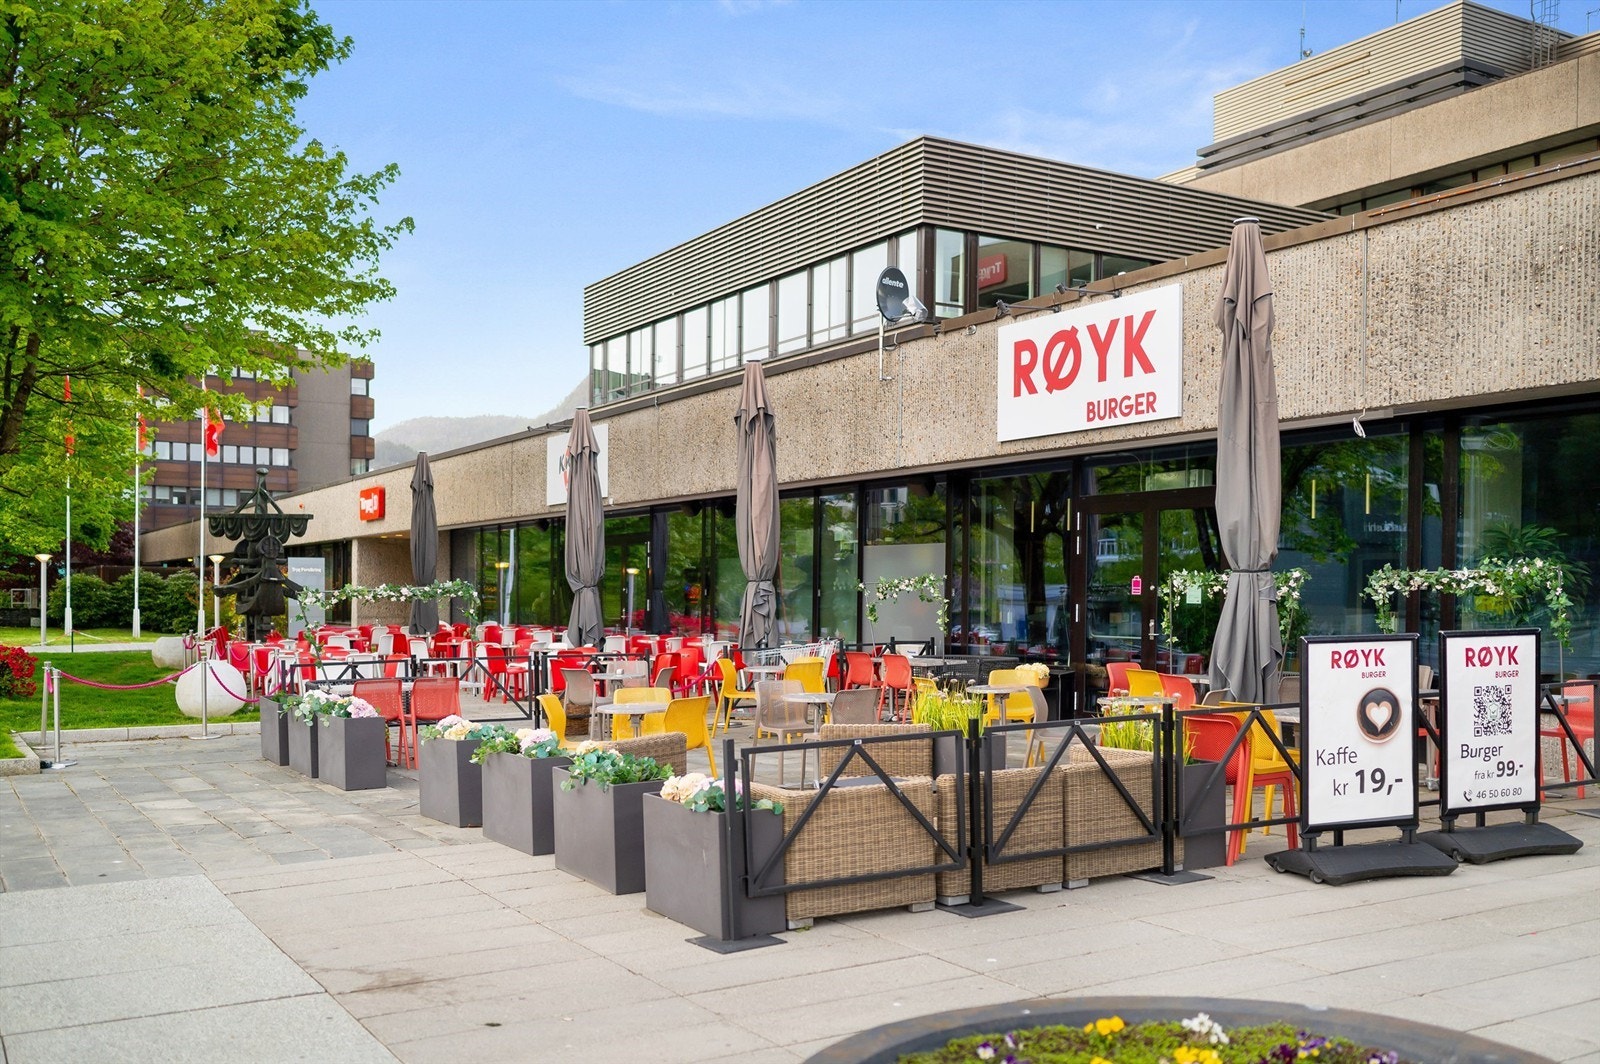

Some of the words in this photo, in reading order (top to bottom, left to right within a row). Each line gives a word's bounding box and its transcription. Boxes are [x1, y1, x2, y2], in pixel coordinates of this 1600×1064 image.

[881, 276, 904, 289] allente
[1013, 309, 1157, 398] RØYK
[1086, 391, 1157, 423] BURGER
[1330, 648, 1386, 670] RØYK
[1465, 645, 1519, 668] RØYK
[1361, 671, 1387, 679] BURGER
[1495, 670, 1520, 679] BURGER
[1316, 746, 1358, 766] Kaffe
[1460, 743, 1504, 762] Burger
[1474, 770, 1486, 780] fra
[1487, 769, 1495, 779] kr
[1496, 760, 1524, 778] 99,-
[1333, 778, 1349, 796] kr
[1355, 767, 1404, 796] 19,-
[1476, 790, 1487, 799] 46
[1489, 789, 1499, 799] 50
[1500, 788, 1511, 797] 60
[1512, 787, 1523, 796] 80
